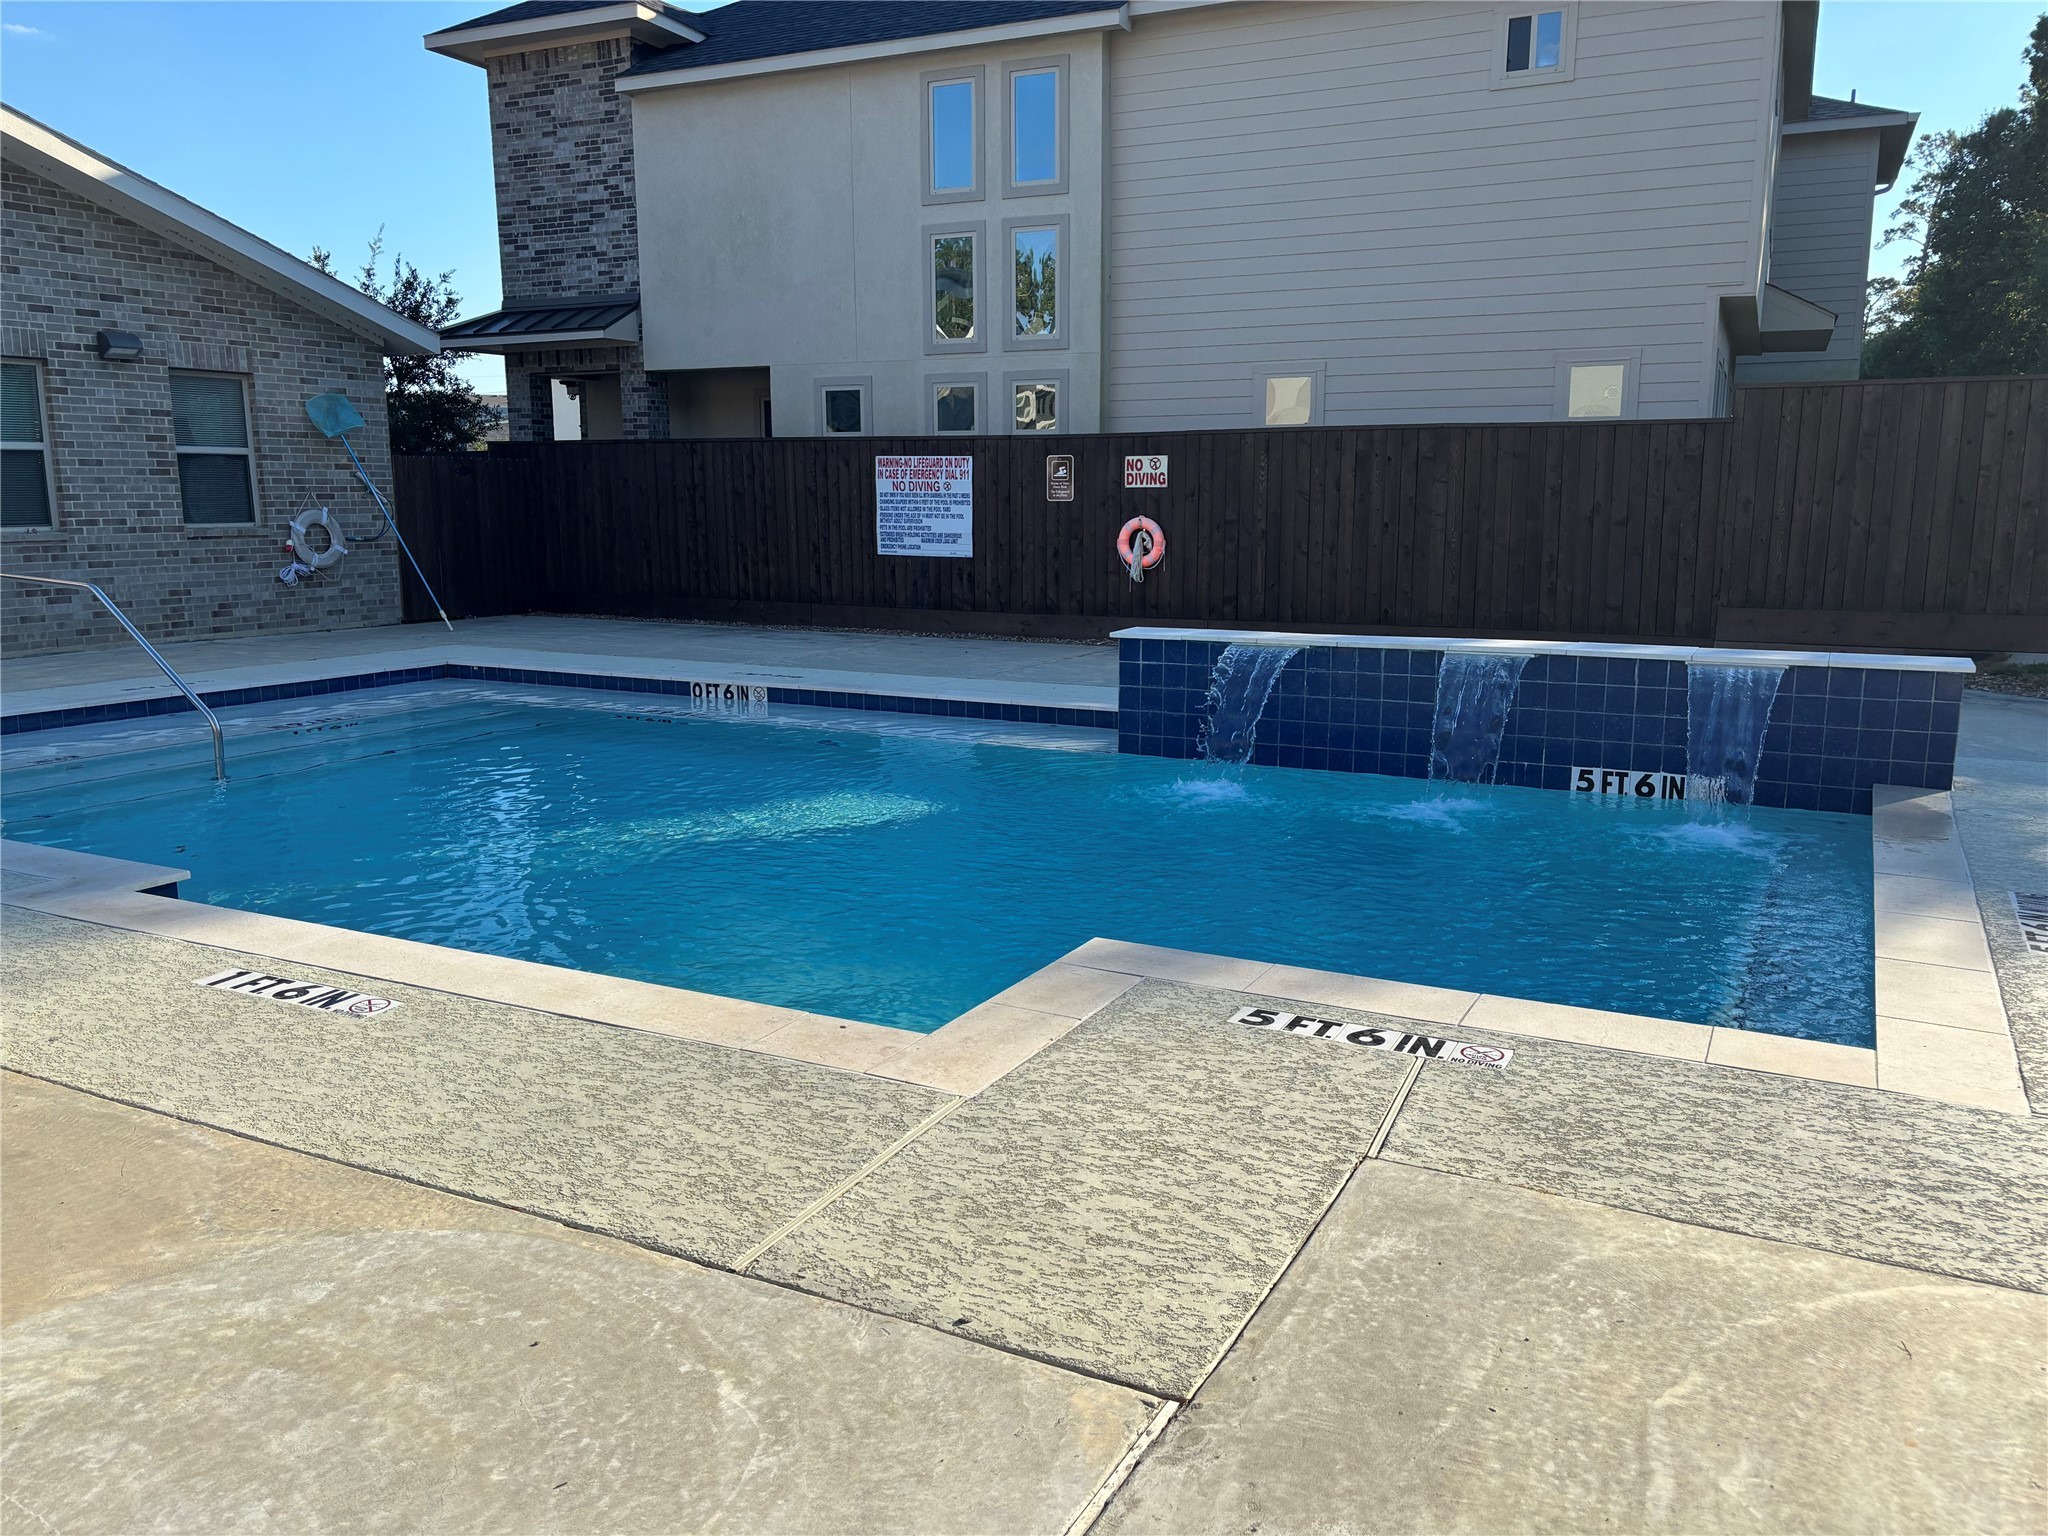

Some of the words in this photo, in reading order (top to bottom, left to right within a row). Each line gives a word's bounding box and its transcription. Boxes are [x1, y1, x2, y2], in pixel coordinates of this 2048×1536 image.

[878, 458, 912, 468] WARNING-NO
[914, 458, 943, 468] LIFEGUARD
[945, 458, 953, 468] ON
[955, 458, 970, 468] DUTY
[1127, 459, 1143, 471] NO
[878, 469, 883, 479] IN
[885, 469, 899, 479] CASE
[901, 469, 908, 479] OF
[910, 469, 943, 479] EMERGENCY
[945, 469, 958, 479] DIAL
[960, 469, 969, 479] 911
[1127, 473, 1166, 485] DIVING
[893, 481, 906, 492] NO
[909, 481, 940, 492] DIVING
[706, 684, 720, 698] FT
[724, 684, 734, 699] 6
[737, 686, 749, 700] IN
[1576, 769, 1594, 792] 5
[1635, 774, 1656, 797] 6
[207, 971, 252, 986] 1
[272, 984, 324, 1000] 6
[1238, 1009, 1279, 1026] 5
[1282, 1016, 1344, 1039] FT.
[1346, 1028, 1386, 1046] 6
[1394, 1034, 1448, 1059] IN.
[1467, 1061, 1503, 1069] DIVING
